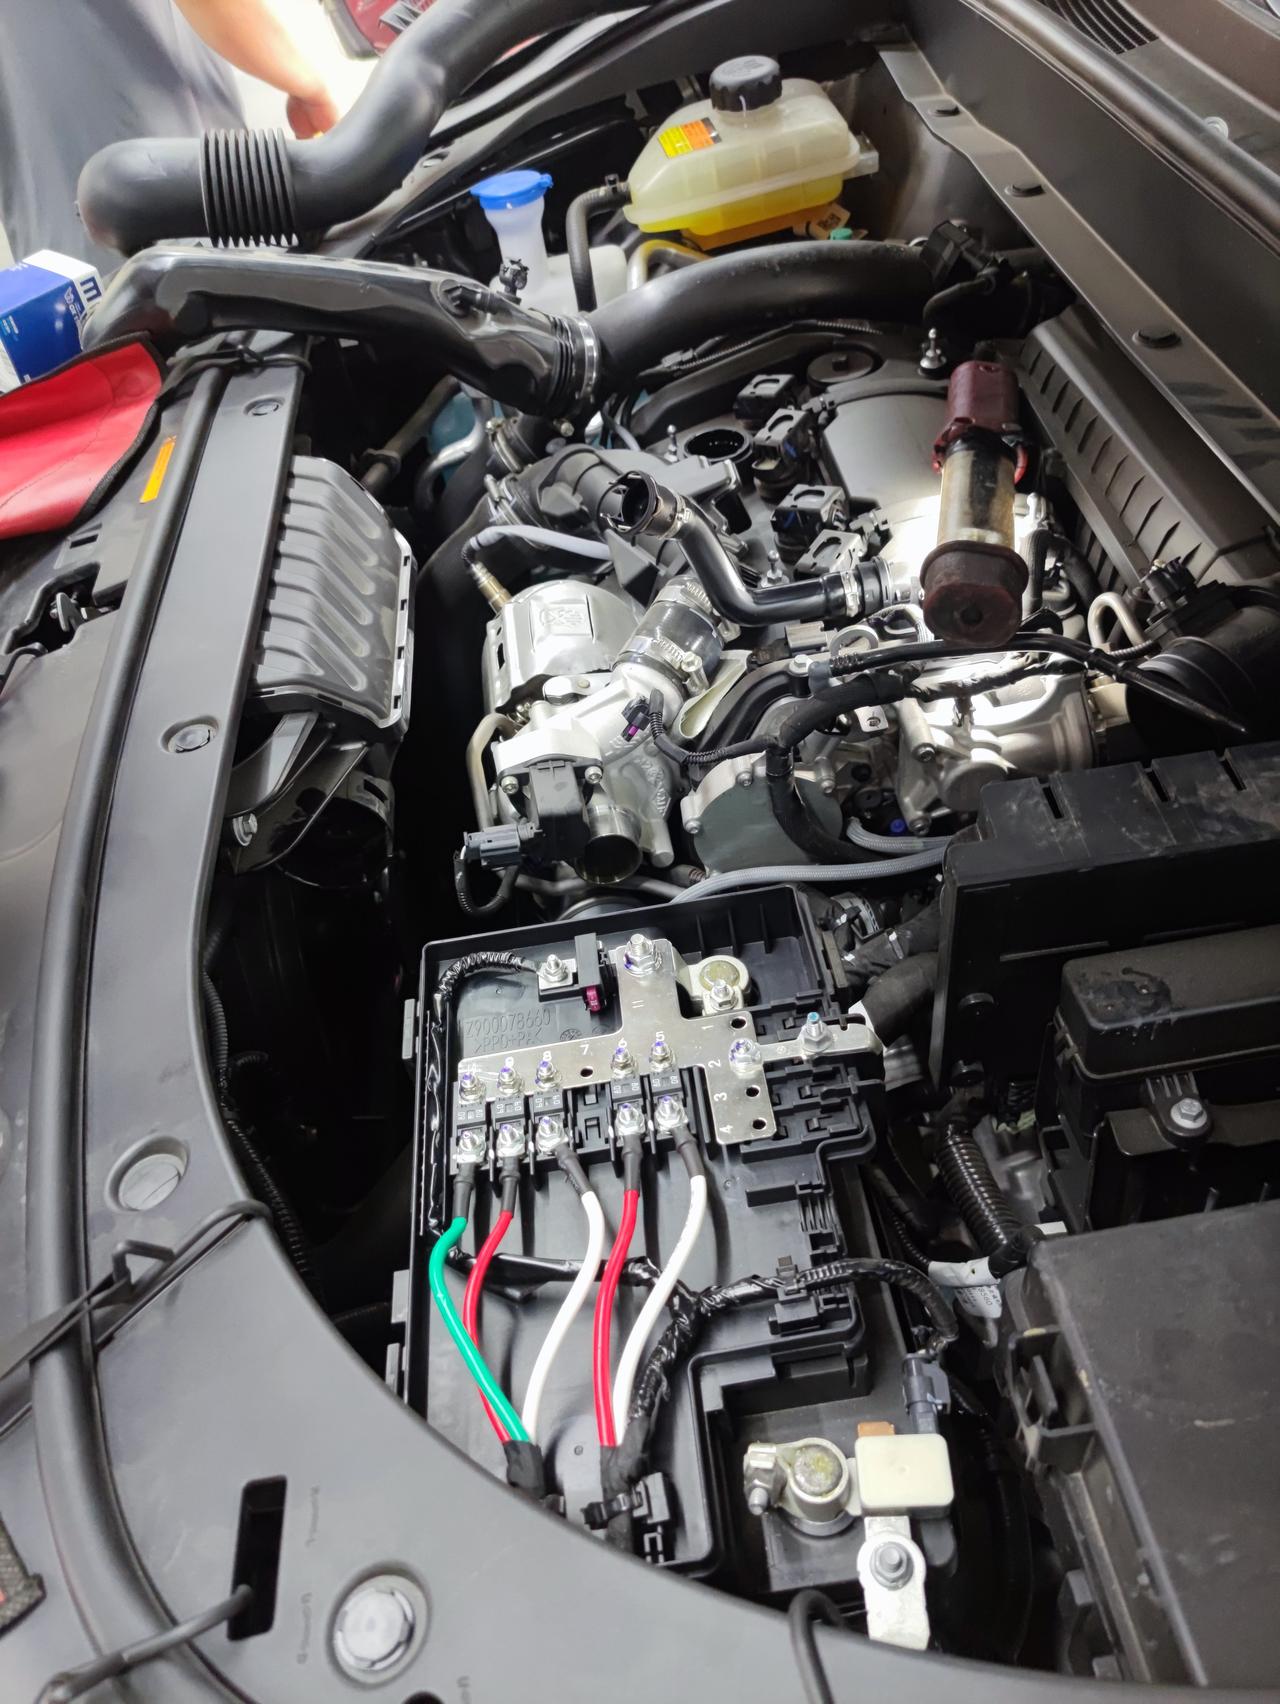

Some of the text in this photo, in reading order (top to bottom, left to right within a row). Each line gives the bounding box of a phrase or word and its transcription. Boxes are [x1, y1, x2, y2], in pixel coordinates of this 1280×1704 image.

[655, 1031, 665, 1042] 5
[617, 1037, 628, 1048] 6
[579, 1044, 590, 1055] 7
[542, 1051, 552, 1061] 8
[708, 1059, 721, 1068] 2
[713, 1092, 727, 1101] 3
[719, 1124, 733, 1134] 4
